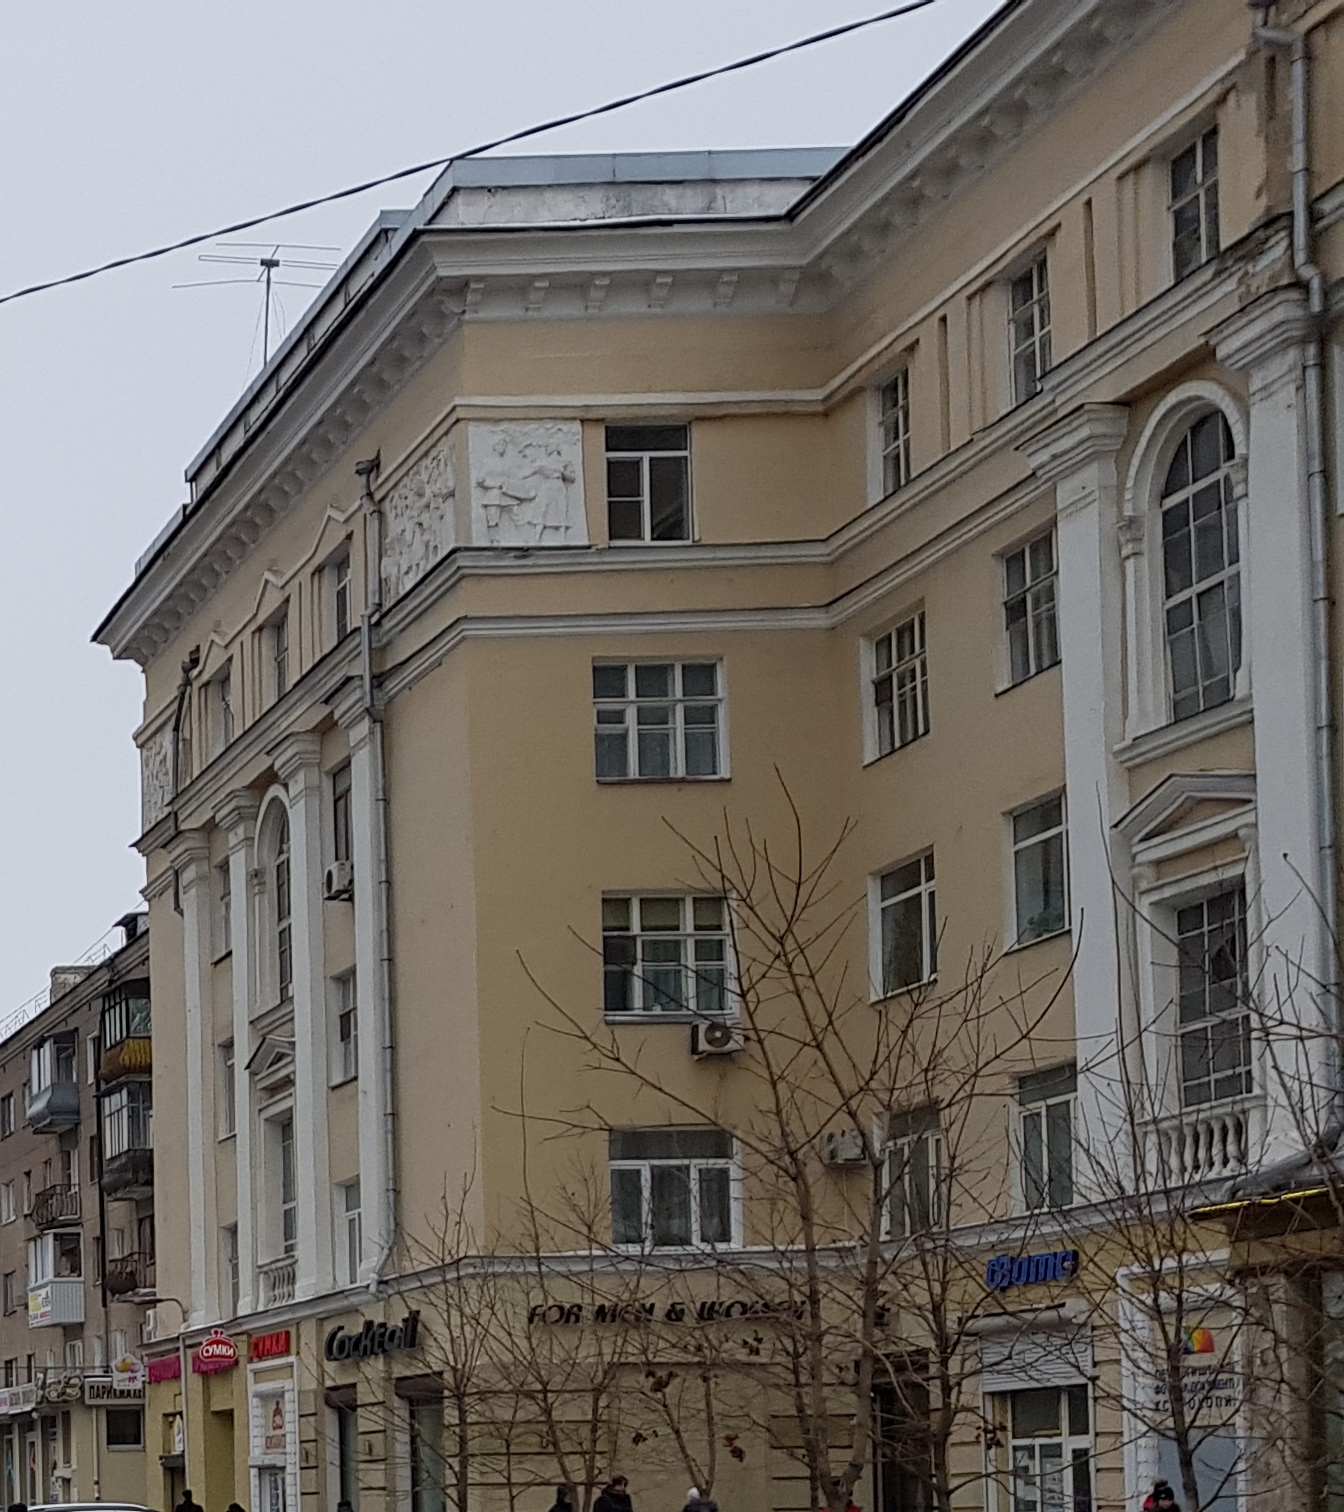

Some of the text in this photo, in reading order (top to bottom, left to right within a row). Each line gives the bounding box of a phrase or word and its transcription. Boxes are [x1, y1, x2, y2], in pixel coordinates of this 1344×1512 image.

[528, 1304, 584, 1324] FOR
[665, 1303, 686, 1322] &
[203, 1344, 234, 1358] СУМКИ
